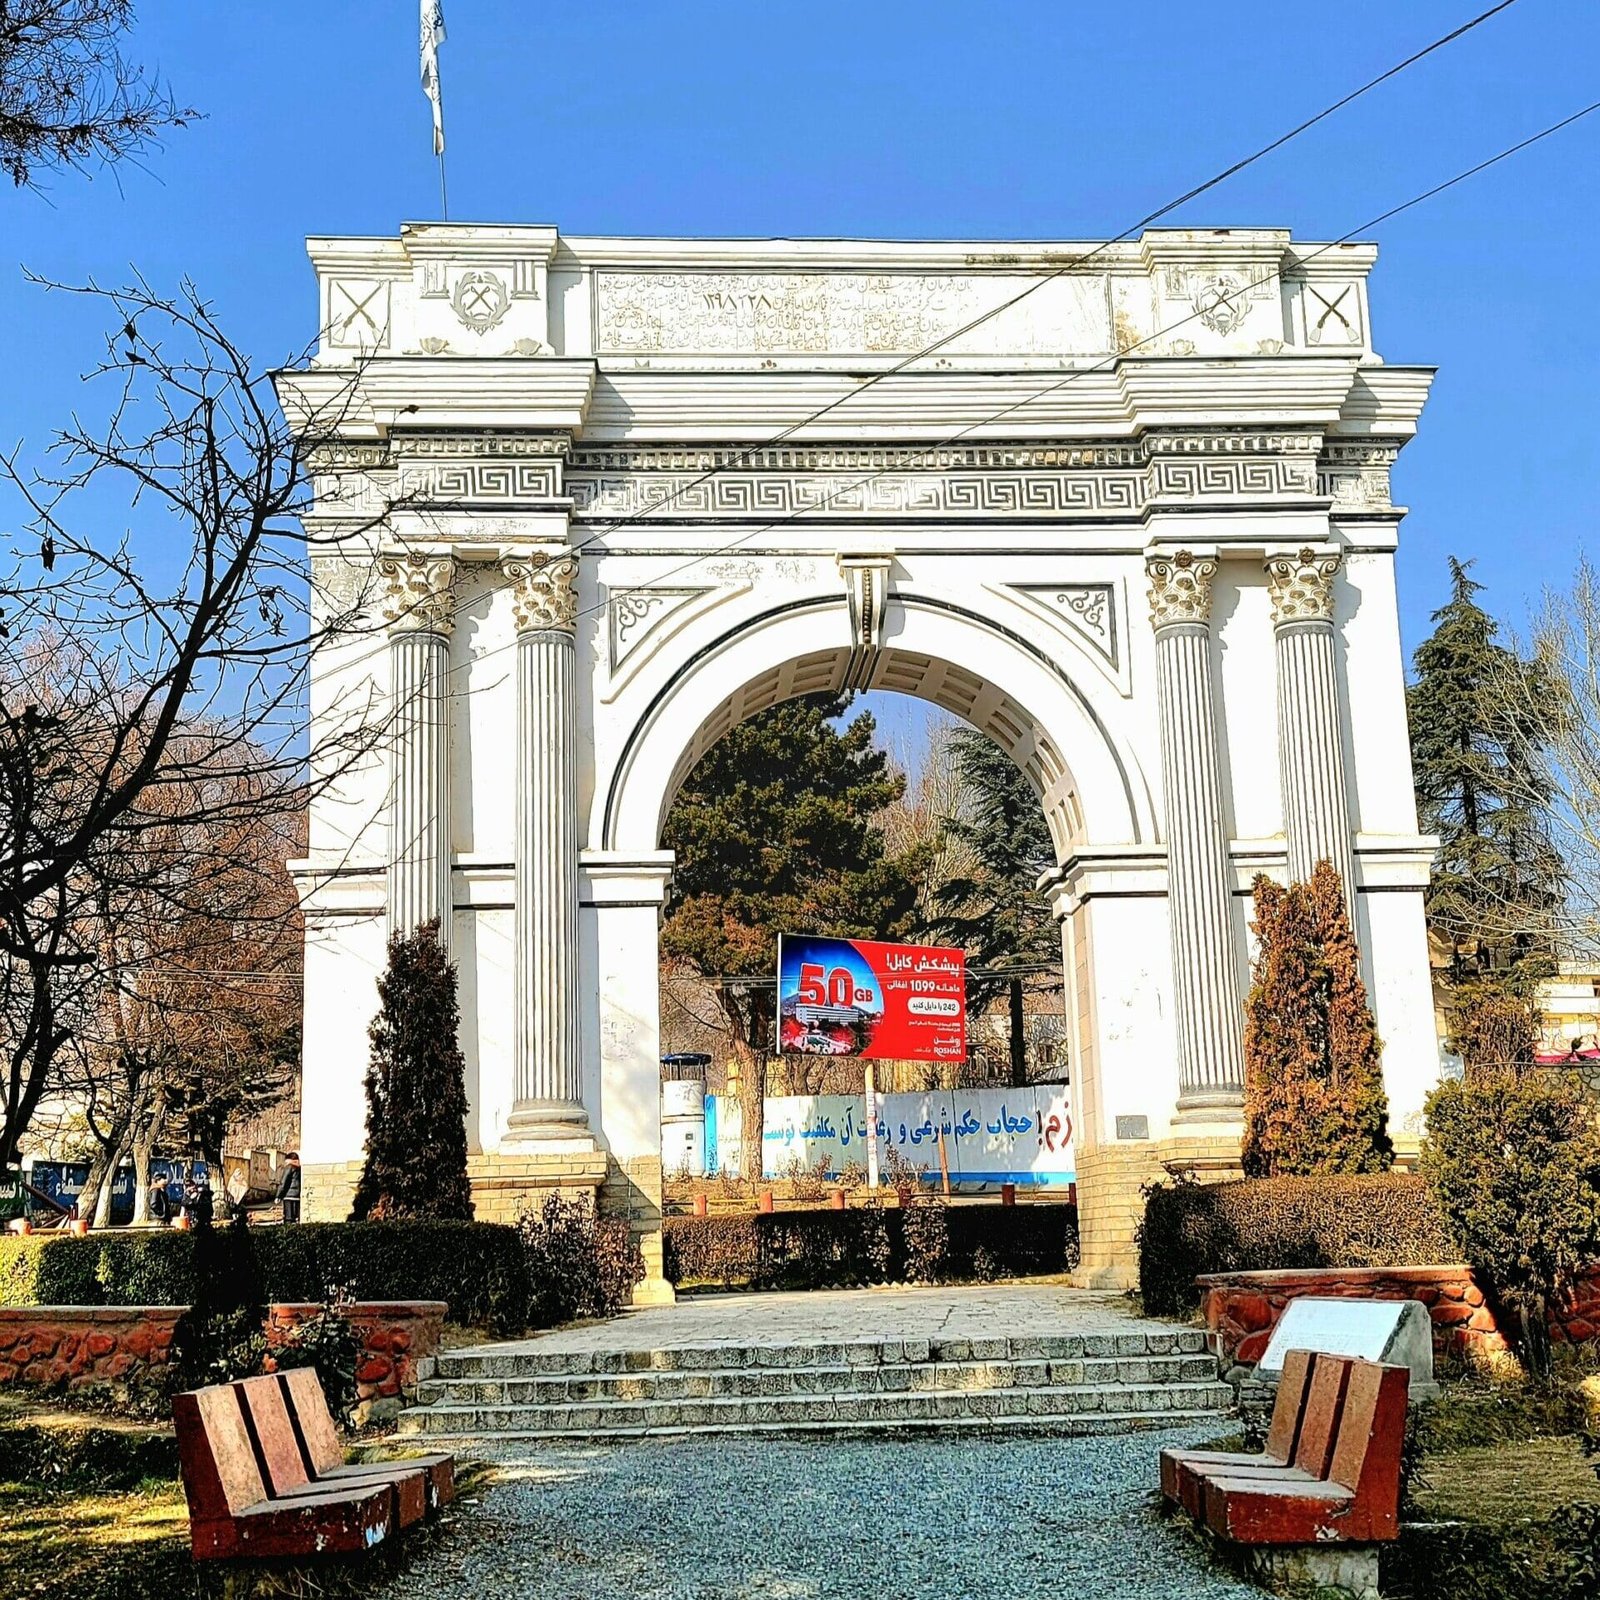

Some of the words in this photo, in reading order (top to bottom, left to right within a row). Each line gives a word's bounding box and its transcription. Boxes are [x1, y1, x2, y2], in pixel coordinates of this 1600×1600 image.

[886, 952, 912, 971] کابل!
[914, 955, 960, 977] پیشکش
[798, 963, 854, 1008] 50
[854, 988, 873, 1003] GB
[886, 980, 908, 990] افغانی
[910, 979, 935, 992] 1099
[938, 1002, 943, 1011] را
[943, 1003, 956, 1012] 242
[934, 1047, 961, 1057] ROSHAN
[799, 1116, 836, 1147] مکلفیت
[840, 1106, 854, 1147] آن
[857, 1113, 892, 1145] رعات
[899, 1122, 906, 1144] و
[910, 1107, 953, 1145] شرعی
[954, 1109, 981, 1145] حکم
[987, 1104, 1033, 1142] حجاب
